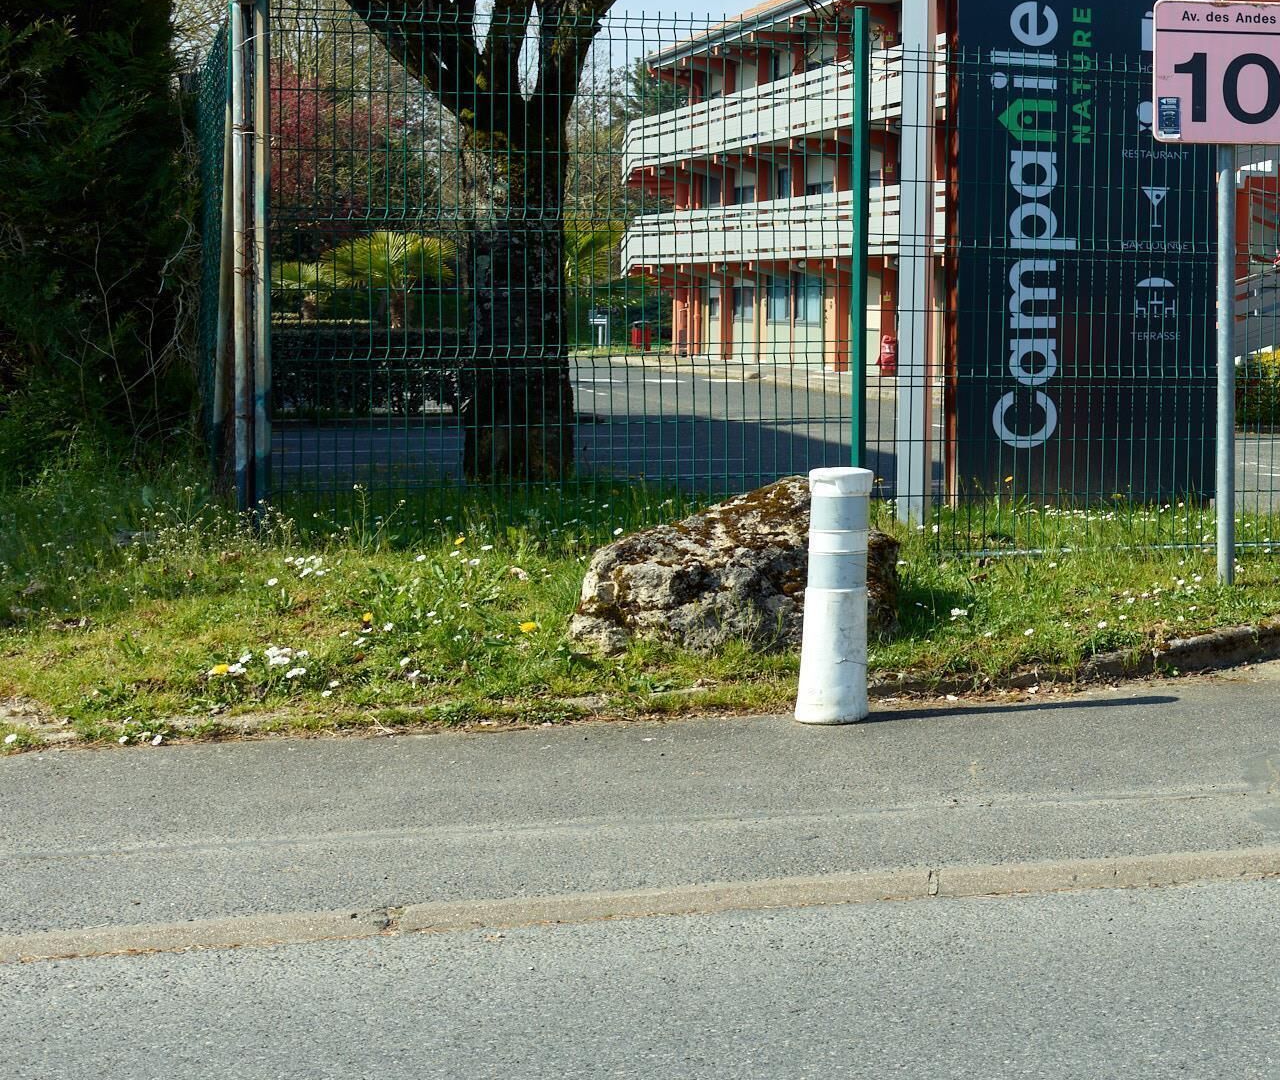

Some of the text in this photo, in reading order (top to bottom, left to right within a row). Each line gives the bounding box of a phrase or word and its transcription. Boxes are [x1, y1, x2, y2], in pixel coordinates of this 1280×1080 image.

[1182, 10, 1277, 24] Av. des Andes
[1072, 7, 1092, 144] NATURE
[1121, 149, 1190, 160] RESTAURANT
[990, 1, 1076, 449] Campanile
[1130, 331, 1181, 341] TERRASSE
